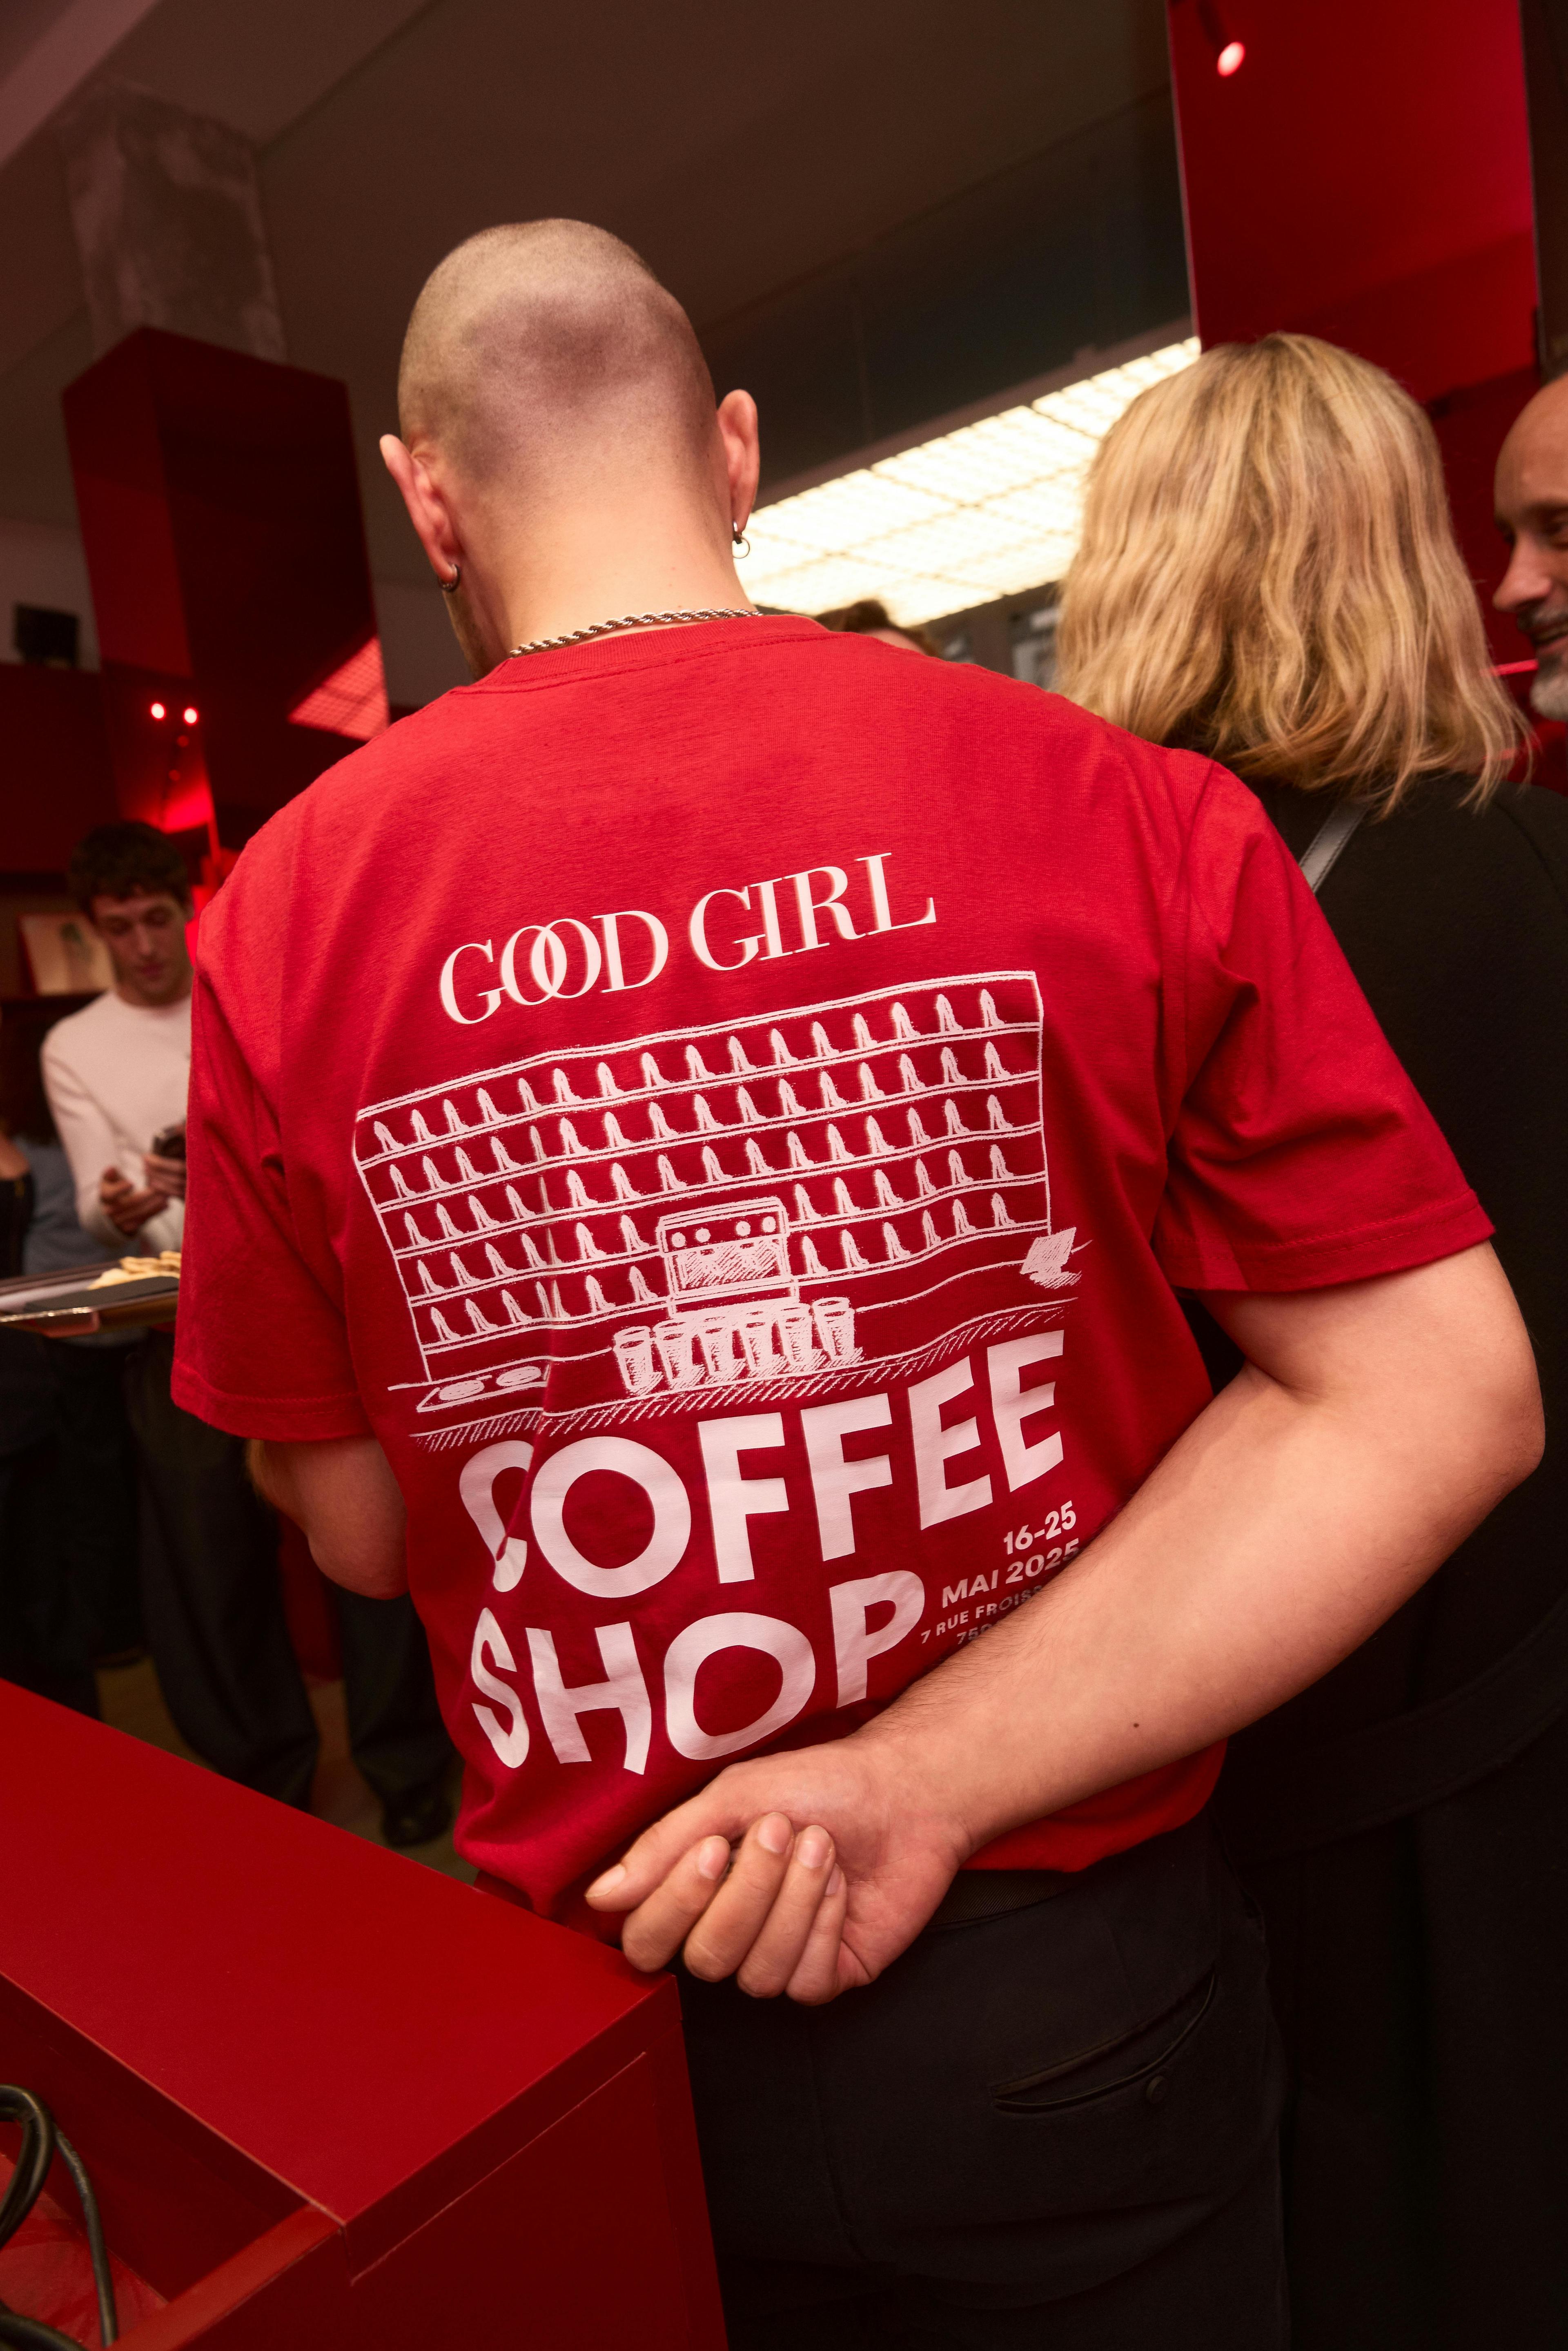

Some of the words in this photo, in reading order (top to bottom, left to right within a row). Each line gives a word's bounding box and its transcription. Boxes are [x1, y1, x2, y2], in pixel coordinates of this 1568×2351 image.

[439, 910, 669, 1025] GOOD
[689, 852, 936, 971] GIRL
[459, 1329, 1065, 1598] COFFEE
[942, 1569, 999, 1608] MAI
[1005, 1538, 1080, 1584] 2025
[1003, 1500, 1076, 1555] 16-25
[470, 1570, 926, 1775] SHOP
[921, 1629, 931, 1644] 7
[936, 1611, 969, 1636] RUE
